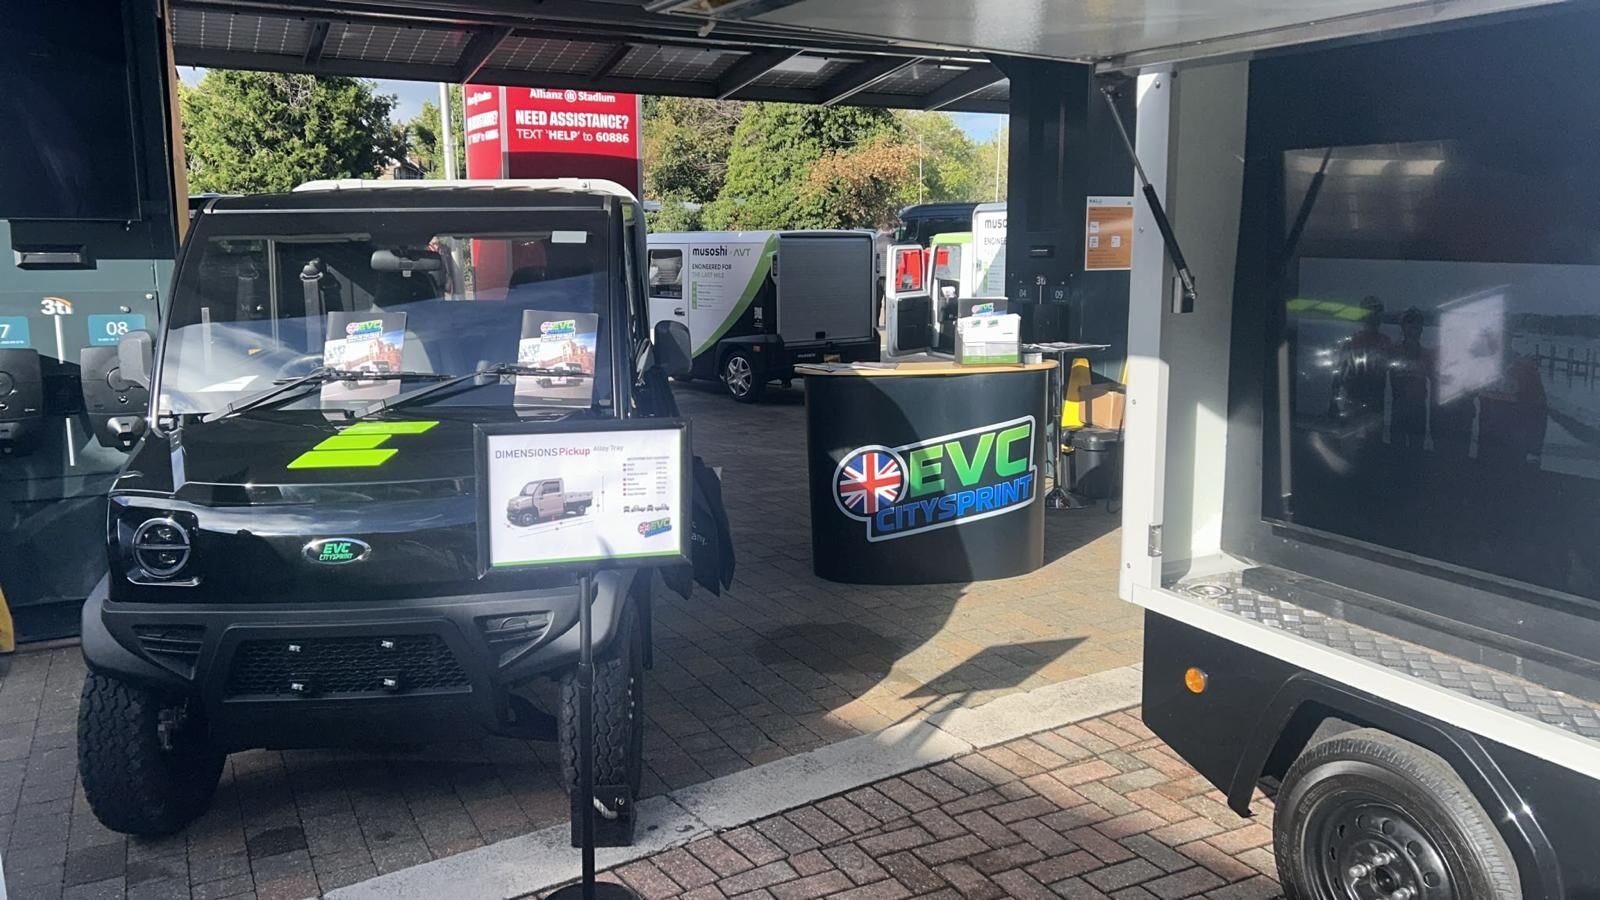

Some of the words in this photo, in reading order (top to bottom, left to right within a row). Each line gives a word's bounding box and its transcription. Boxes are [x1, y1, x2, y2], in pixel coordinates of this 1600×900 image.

[529, 88, 563, 100] Allianz
[578, 90, 615, 103] Stadium
[515, 109, 547, 126] NEED
[549, 111, 629, 129] ASSISTANCE?
[516, 128, 543, 139] TEXT
[583, 131, 593, 142] to
[596, 132, 629, 143] 60886
[984, 219, 1007, 229] muso
[692, 246, 728, 256] musoshi
[691, 263, 721, 271] ENGINEERED
[722, 263, 732, 271] FOR
[0, 324, 11, 339] 7
[106, 321, 129, 336] 08
[495, 447, 558, 459] DIMENSIONS
[559, 447, 590, 457] Pickup
[909, 423, 1031, 498] EVC
[876, 474, 1033, 532] CITYSPRINT
[323, 543, 351, 554] EVC
